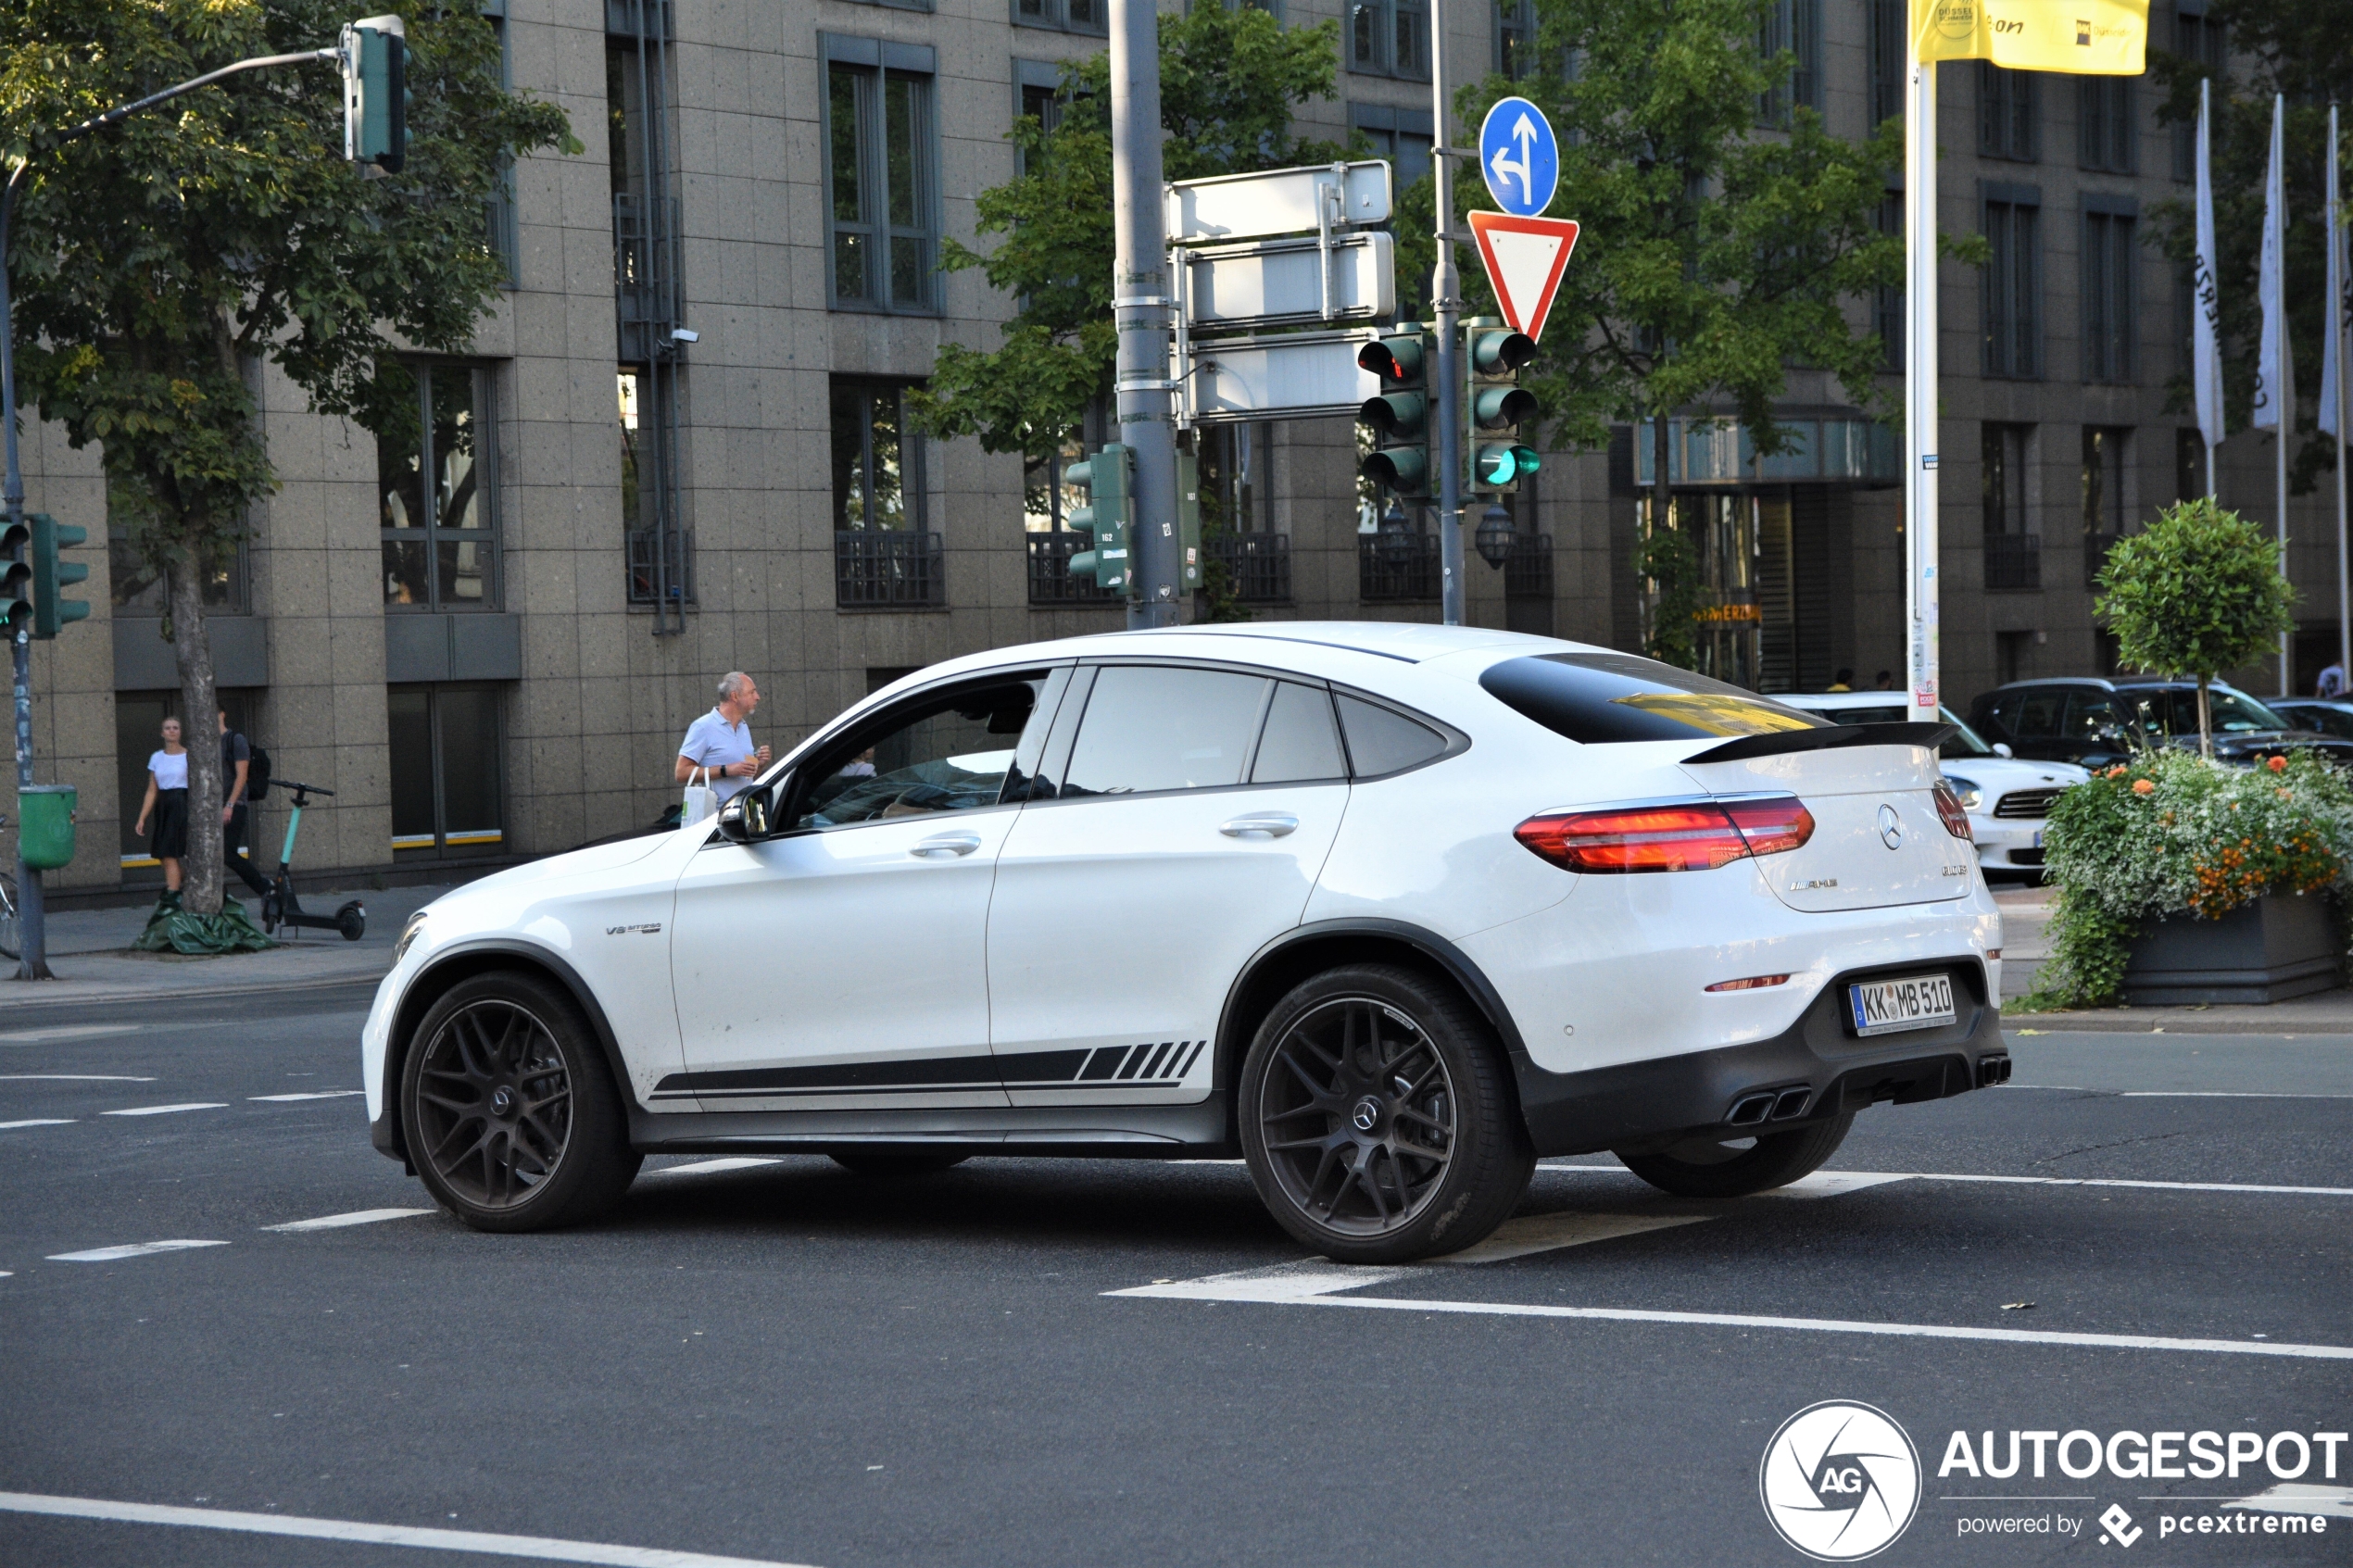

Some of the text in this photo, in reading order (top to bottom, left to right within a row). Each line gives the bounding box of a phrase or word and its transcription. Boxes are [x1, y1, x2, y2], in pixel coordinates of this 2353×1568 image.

[1939, 6, 1973, 16] DÜSSEL
[1187, 493, 1196, 501] 161
[1101, 533, 1113, 542] 162
[607, 926, 626, 935] V8
[1862, 980, 1952, 1022] KK MB 510
[1857, 1010, 1863, 1021] D
